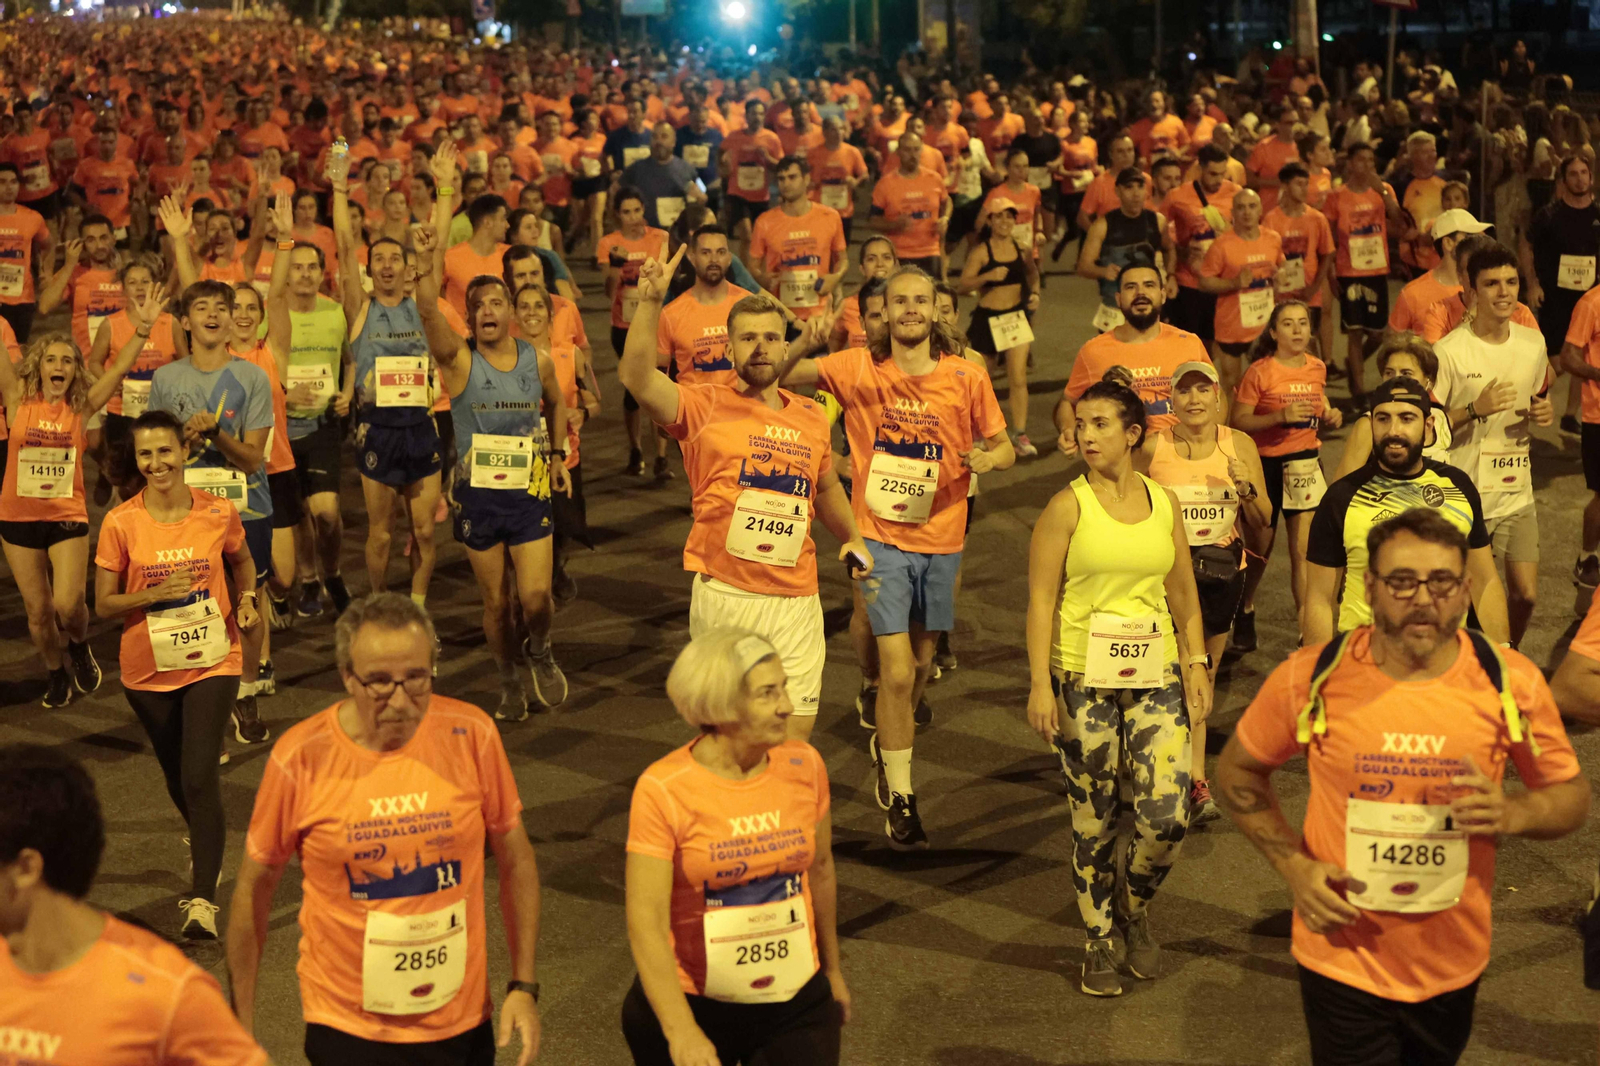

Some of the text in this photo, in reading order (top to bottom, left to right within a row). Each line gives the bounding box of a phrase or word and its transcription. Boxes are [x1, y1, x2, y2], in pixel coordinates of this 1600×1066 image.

[394, 374, 415, 385] 132
[1131, 366, 1161, 377] XXXV
[895, 398, 929, 412] XXXV
[884, 413, 940, 427] GUADALQUIVIR
[908, 411, 940, 420] NOCTURNA
[748, 434, 812, 452] CARRERA NOCTURNA
[764, 425, 802, 443] XXXV
[753, 441, 811, 460] GUADALQUIVIR
[489, 454, 512, 467] 921
[1491, 456, 1529, 468] 16415
[30, 465, 65, 477] 14119
[880, 478, 925, 497] 22565
[1182, 507, 1225, 520] 10091
[745, 516, 794, 537] 21494
[155, 547, 194, 563] XXXV
[174, 558, 209, 568] NOCTURNA
[170, 625, 209, 646] 7947
[1109, 643, 1150, 658] 5637
[1381, 732, 1447, 755] XXXV
[1354, 753, 1404, 763] CARRERA
[368, 791, 429, 818] XXXV
[347, 811, 452, 830] CARRERA NOCTURNA
[729, 810, 781, 837] XXXV
[353, 820, 453, 841] GUADALQUIVIR
[709, 828, 804, 850] CARRERA NOCTURNA
[717, 836, 807, 860] GUADALQUIVIR
[1368, 841, 1446, 866] 14286
[394, 945, 448, 972] 2856
[736, 939, 789, 966] 2858
